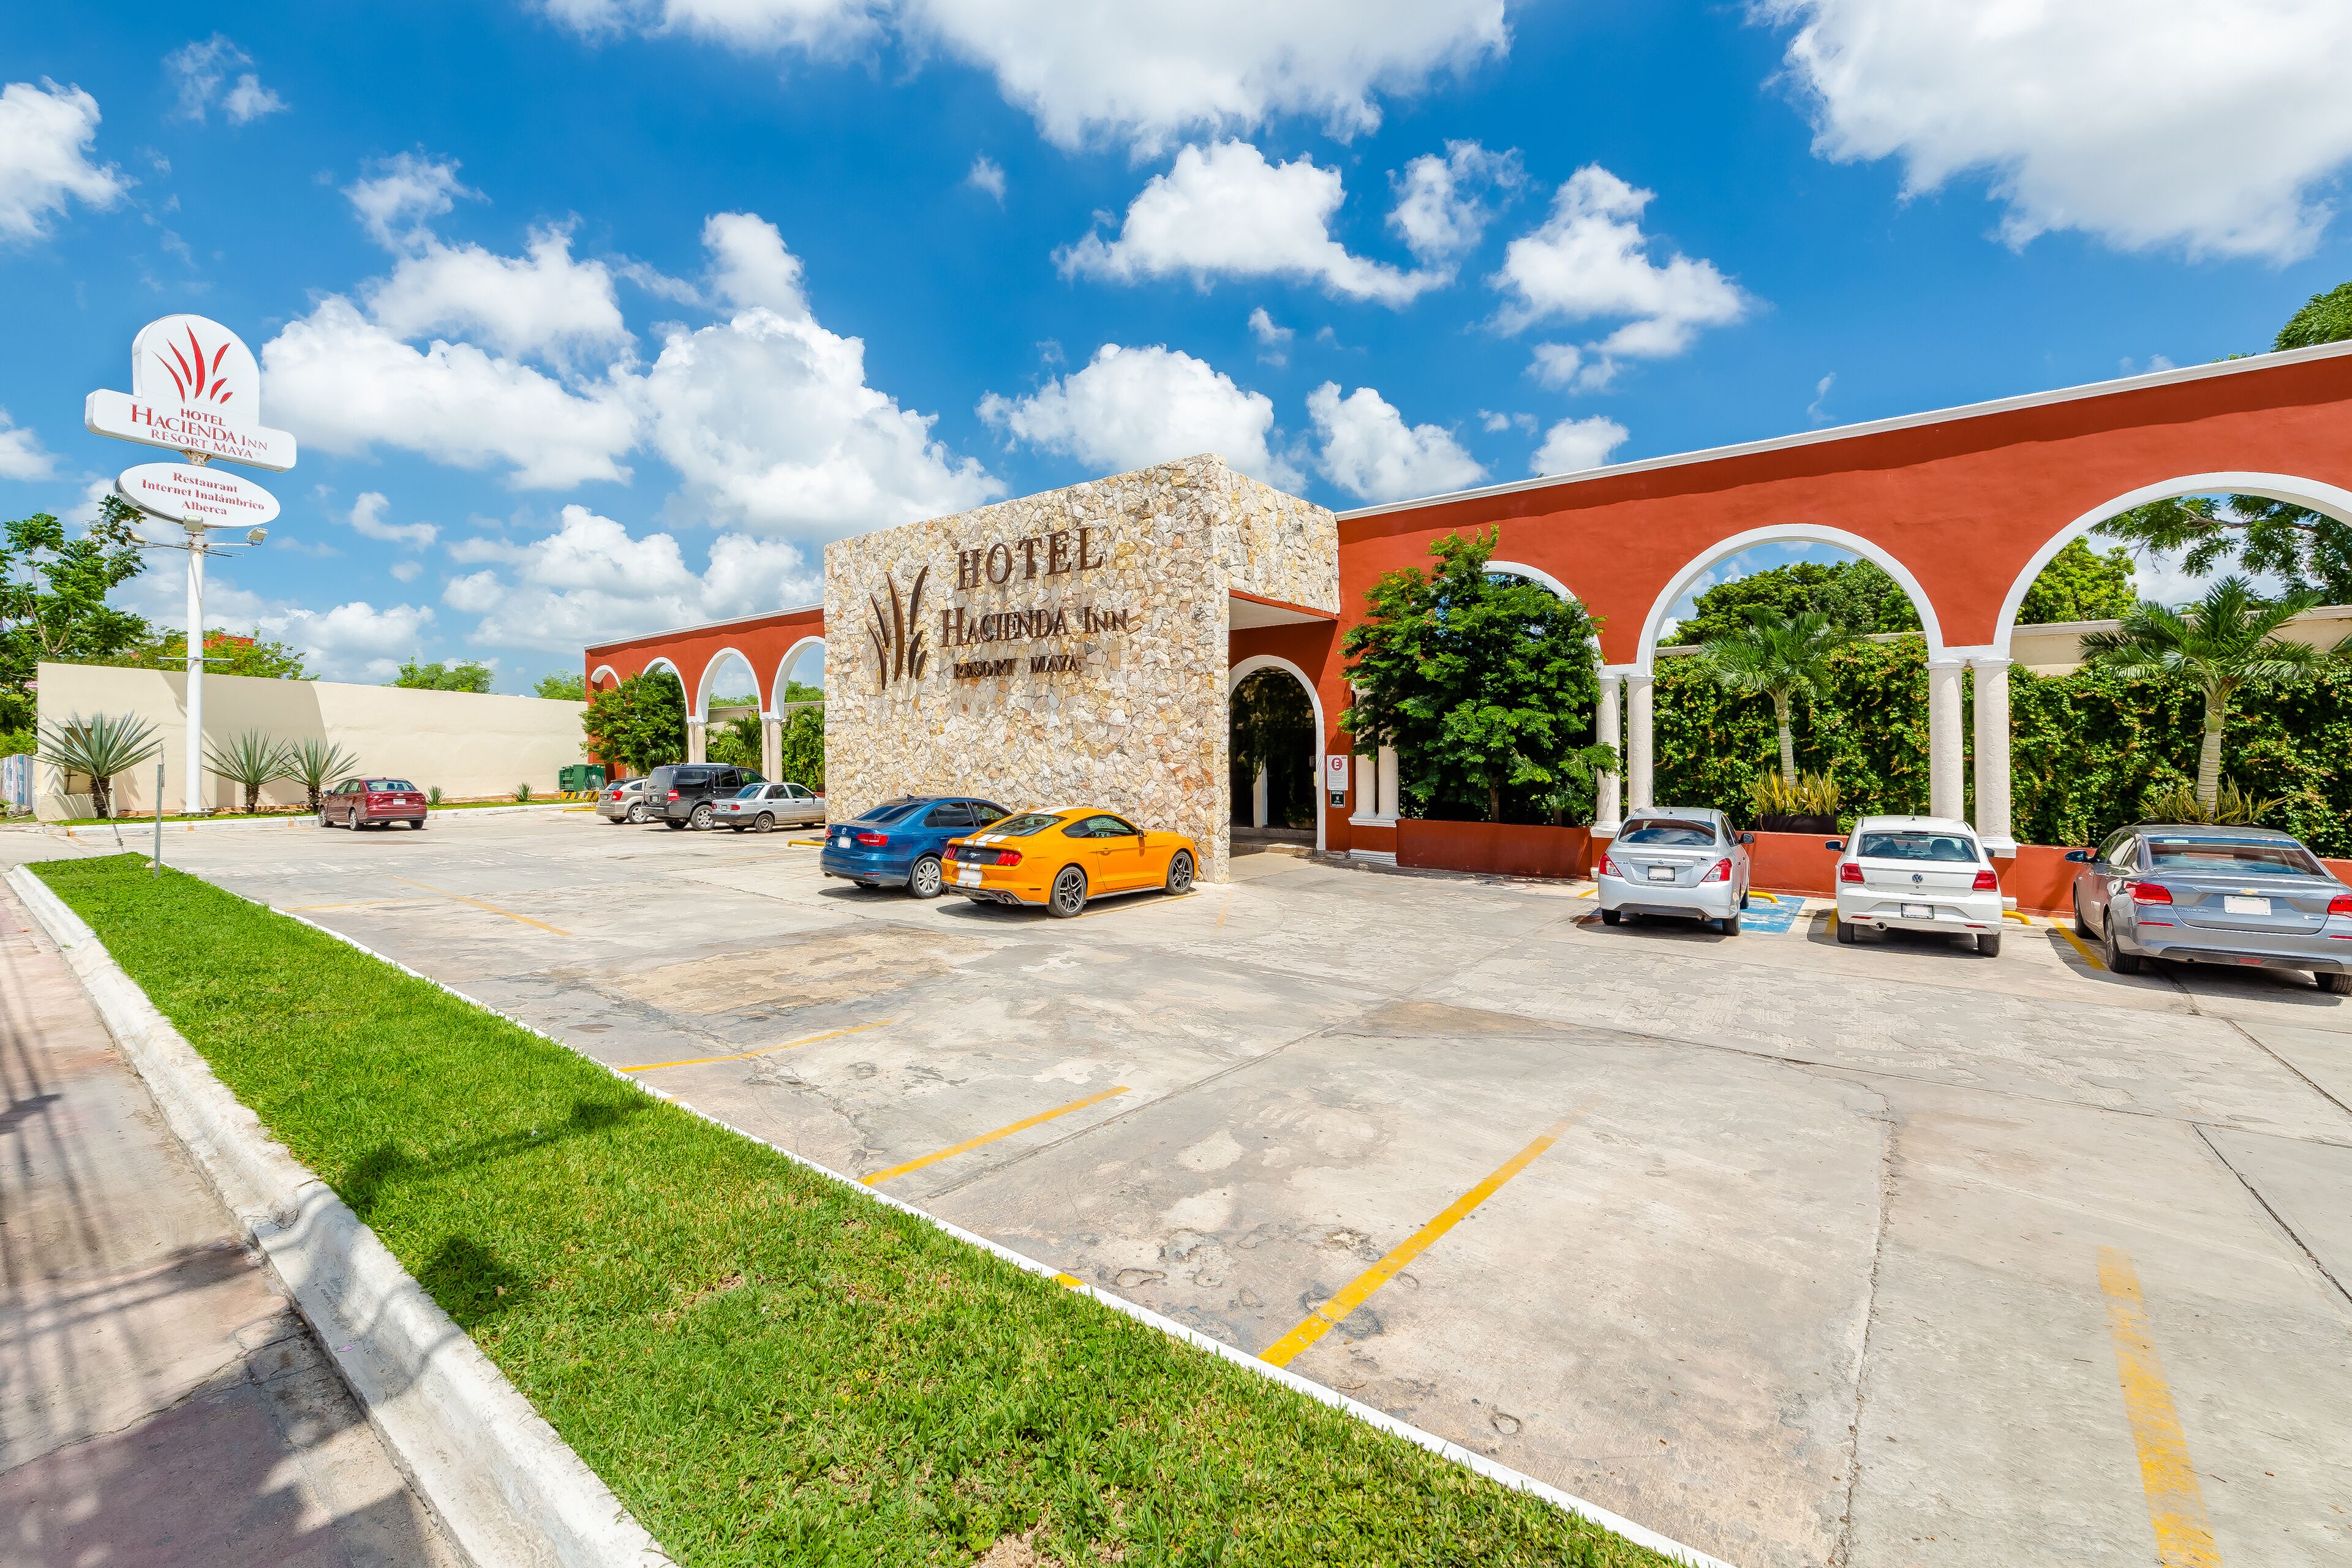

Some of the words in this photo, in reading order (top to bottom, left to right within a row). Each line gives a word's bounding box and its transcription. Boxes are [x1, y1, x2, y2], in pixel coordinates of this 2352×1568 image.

[130, 403, 237, 444] HACIENDA
[242, 435, 267, 450] INN
[181, 407, 225, 427] HOTEL
[151, 429, 208, 449] RESORT
[214, 441, 253, 459] MAYA
[142, 479, 191, 497] Internet
[195, 489, 264, 510] Inalámbrico
[173, 472, 237, 492] Restaurant
[181, 500, 227, 515] Alberca
[958, 527, 1102, 590] HOTEL
[940, 606, 1071, 647] HACIENDA
[1084, 606, 1129, 634] INN
[954, 659, 1016, 679] RESORT
[1030, 655, 1082, 674] MAYA
[1334, 760, 1340, 769] E
